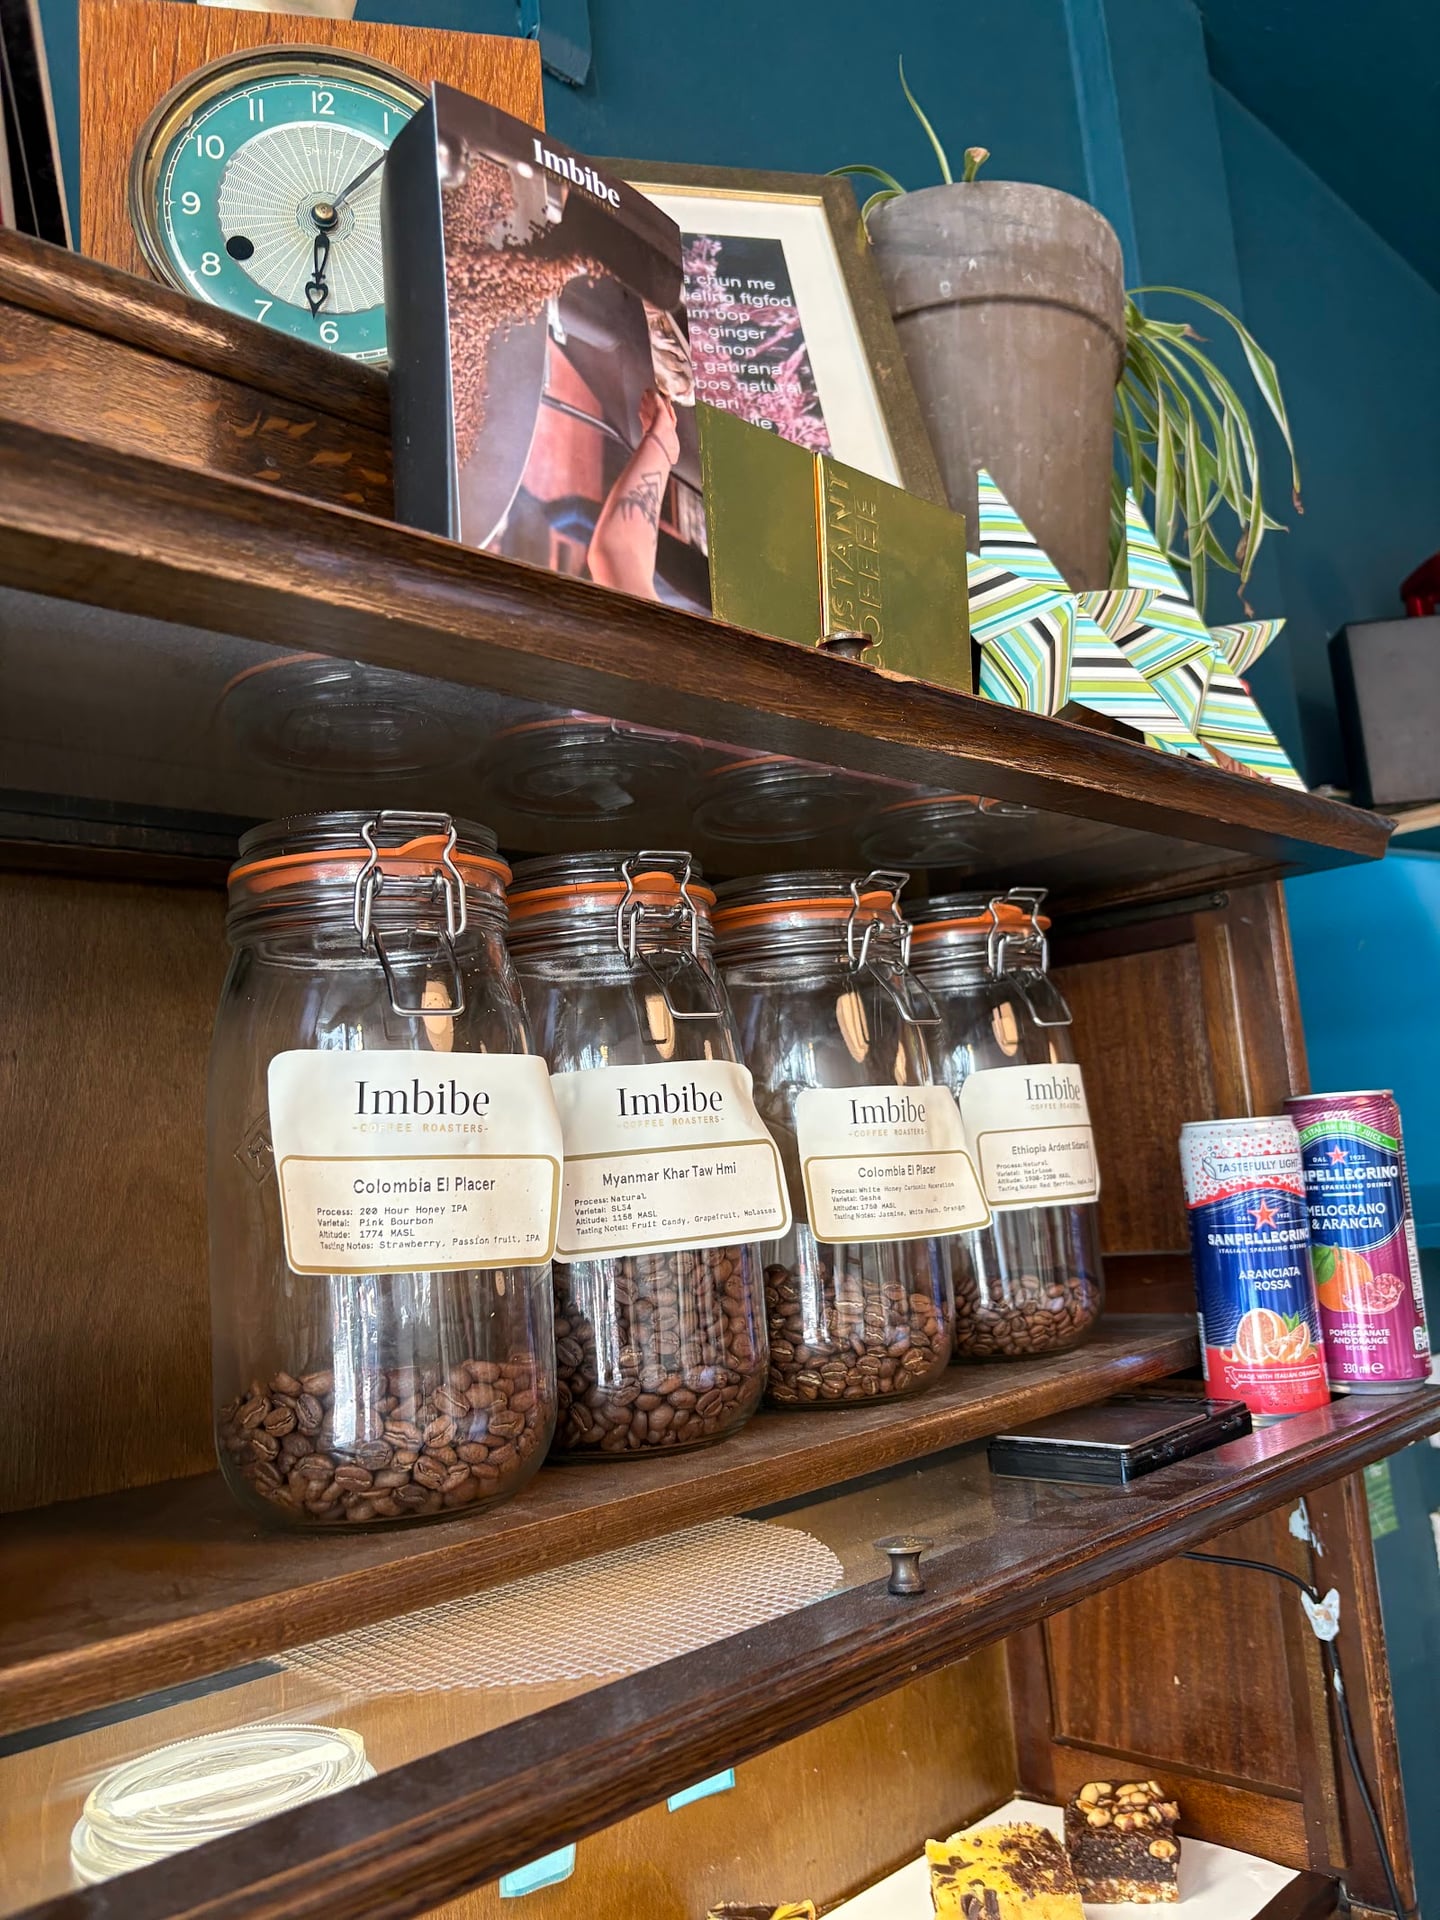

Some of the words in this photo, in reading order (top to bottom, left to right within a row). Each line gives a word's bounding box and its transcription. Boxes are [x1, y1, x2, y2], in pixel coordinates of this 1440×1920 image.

[249, 98, 264, 122] 11
[311, 91, 335, 115] 12
[383, 112, 389, 135] 1
[197, 134, 225, 159] 10
[533, 138, 620, 209] Imbibe
[181, 192, 201, 215] 9
[200, 252, 222, 276] 8
[747, 279, 776, 290] me
[740, 292, 791, 308] ftgfod
[254, 299, 273, 322] 7
[715, 308, 751, 324] bop
[319, 321, 339, 343] 6
[708, 325, 767, 341] ginger
[698, 342, 757, 357] lemon
[704, 361, 783, 375] gaurana
[736, 379, 802, 394] natural
[1024, 1076, 1080, 1101] Imbibe
[353, 1079, 490, 1118] Imbibe
[616, 1082, 723, 1117] Imbibe
[849, 1096, 926, 1125] Imbibe
[1012, 1143, 1047, 1155] Ethiopia
[858, 1165, 906, 1178] Colombia
[907, 1165, 915, 1175] El
[916, 1164, 936, 1176] Placer
[1217, 1160, 1276, 1173] TASTEFULLY
[1279, 1158, 1299, 1169] LIGHT
[602, 1170, 660, 1188] Myanmar
[663, 1167, 690, 1180] Khar
[692, 1164, 713, 1177] Taw
[716, 1162, 737, 1175] Hmi
[353, 1178, 431, 1194] Colombia
[437, 1177, 449, 1192] El
[455, 1176, 496, 1192] Placer
[574, 1197, 609, 1206] Process:
[610, 1193, 647, 1203] Natural
[317, 1207, 353, 1216] Process:
[384, 1207, 409, 1215] Hour
[416, 1205, 446, 1215] Honey
[451, 1204, 467, 1213] IPA
[575, 1207, 607, 1216] Varietal:
[1307, 1202, 1386, 1217] MELOGRANO
[318, 1218, 350, 1227] Varietal:
[359, 1218, 384, 1226] Pink
[391, 1217, 434, 1226] Bourbon
[576, 1216, 608, 1225] Altitude:
[637, 1210, 658, 1219] MASL
[1311, 1220, 1320, 1230] &
[1322, 1217, 1382, 1230] ARANCIA
[359, 1230, 383, 1239] 1774
[391, 1229, 415, 1237] MASL
[577, 1226, 603, 1236] Tasting
[604, 1224, 628, 1233] Notes:
[632, 1221, 657, 1229] Fruit
[347, 1241, 374, 1250] Notes:
[452, 1237, 490, 1247] Passion
[526, 1234, 541, 1243] IPA
[1238, 1266, 1301, 1280] ARANCIATA
[1254, 1279, 1292, 1291] ROSSA
[1329, 1328, 1391, 1337] POMEGRANATE
[1333, 1337, 1351, 1345] AND
[1352, 1337, 1388, 1345] ORANGE
[1343, 1363, 1358, 1374] 330
